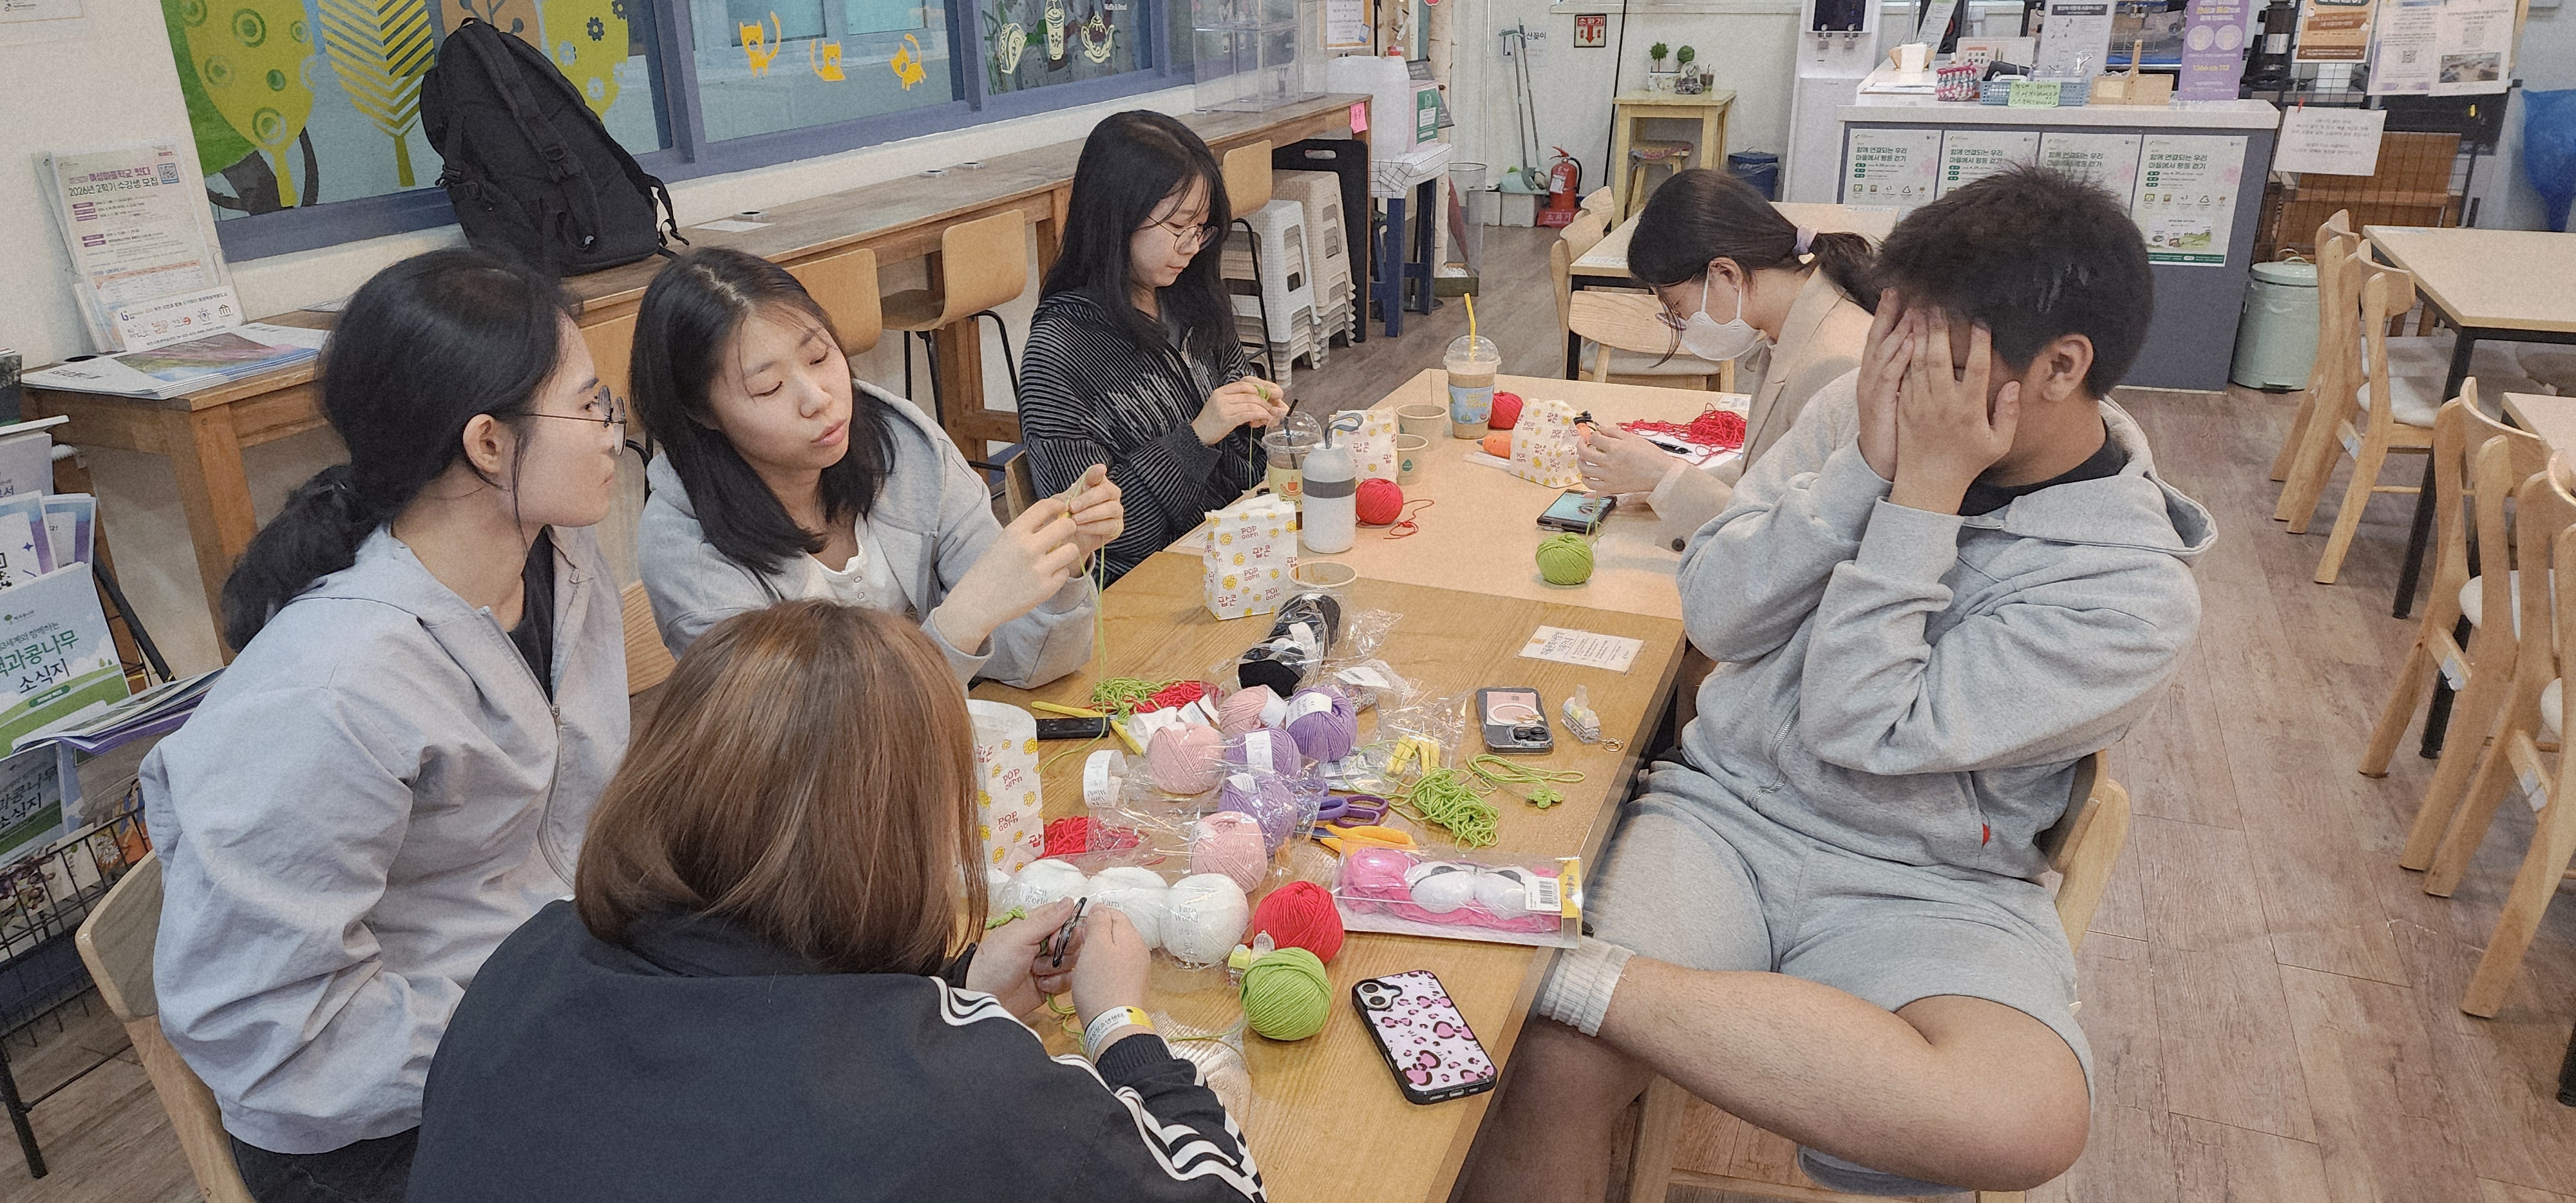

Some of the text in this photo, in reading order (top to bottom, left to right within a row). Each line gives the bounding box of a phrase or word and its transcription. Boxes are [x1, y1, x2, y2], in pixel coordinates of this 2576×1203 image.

[1578, 17, 1603, 26] 소화기
[68, 176, 159, 197] 2026년 2학기 수강생 모집
[1353, 442, 1370, 453] 팝콘
[1241, 526, 1256, 534] POP
[1252, 545, 1271, 558] 팝콘
[1244, 567, 1258, 576] POP
[1244, 573, 1260, 581] corn
[1218, 594, 1236, 607] 팝콘
[29, 622, 60, 639] 함께하는
[19, 658, 70, 694] 소식지
[1003, 768, 1020, 784] POP
[1005, 776, 1023, 791] corn
[0, 792, 41, 829] 소식지
[998, 811, 1018, 825] POP
[999, 818, 1018, 831] corn
[1029, 886, 1047, 896] Yarn
[1025, 895, 1048, 905] World
[1102, 898, 1120, 907] Yarn
[1178, 904, 1197, 913] Yarn
[1174, 914, 1198, 923] World
